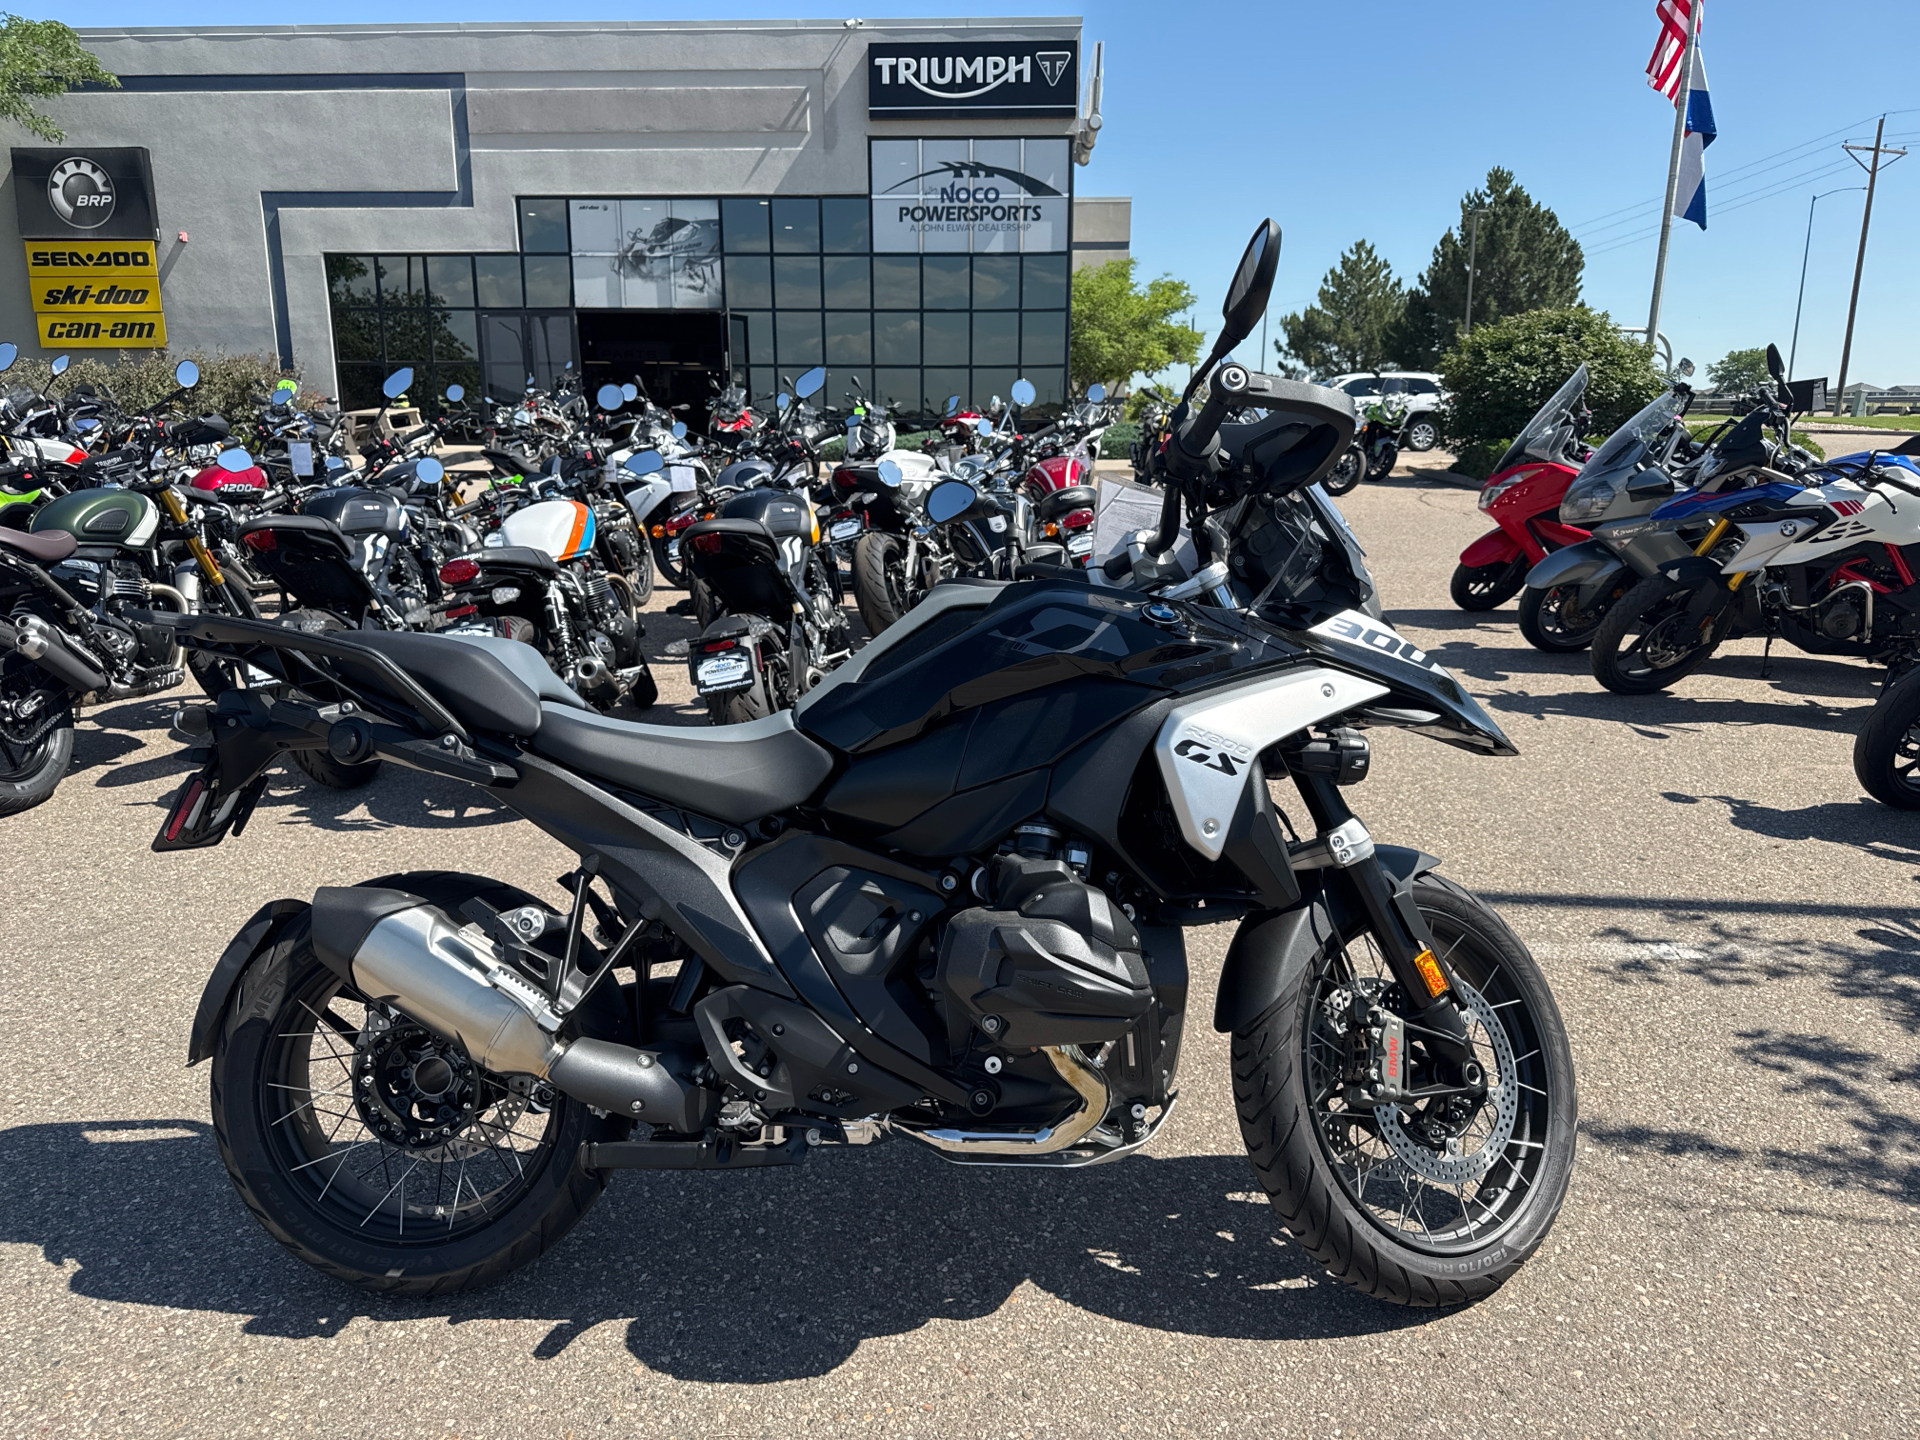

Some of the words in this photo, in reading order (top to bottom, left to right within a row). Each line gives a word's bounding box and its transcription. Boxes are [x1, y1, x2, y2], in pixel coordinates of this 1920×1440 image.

[874, 56, 1031, 98] TRIUMPH
[76, 195, 112, 207] BRP
[940, 181, 1000, 203] NOCO
[899, 205, 1042, 222] POWERSPORTS
[909, 225, 916, 233] A
[918, 224, 945, 232] JOHN
[946, 224, 977, 232] ELWAY
[978, 223, 1032, 232] DEALERSHIP
[43, 285, 149, 305] ski-doo
[47, 322, 155, 339] can-am
[94, 456, 123, 468] TRIUMPH
[222, 483, 252, 493] 1200
[1173, 739, 1248, 776] GS
[1016, 974, 1053, 989] SHIFT
[1056, 985, 1084, 999] CAM
[1387, 1035, 1398, 1077] BMW
